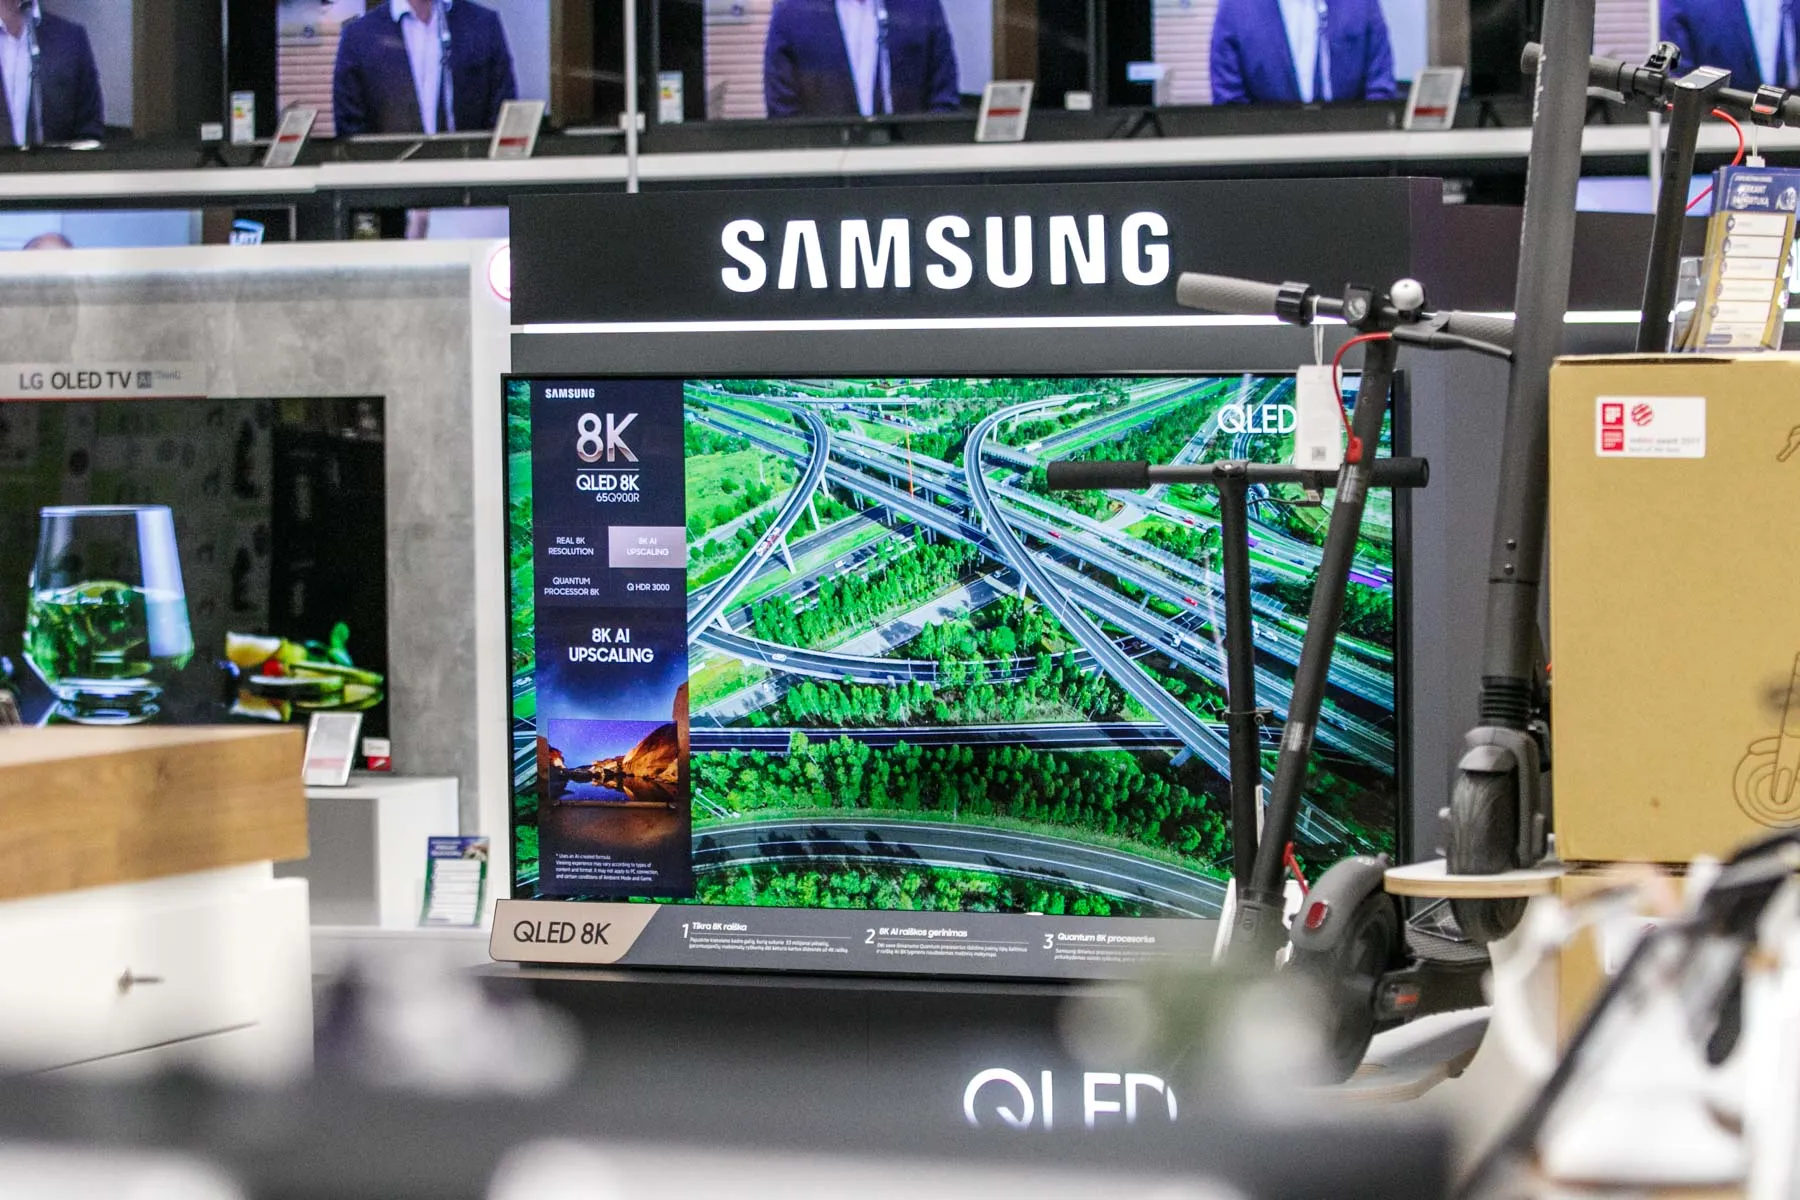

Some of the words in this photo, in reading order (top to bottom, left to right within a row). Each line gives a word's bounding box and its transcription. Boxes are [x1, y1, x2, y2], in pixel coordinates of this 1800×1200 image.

[720, 211, 1171, 293] SAMSUNG
[20, 373, 43, 390] LG
[51, 372, 102, 390] OLED
[105, 371, 132, 389] TV
[545, 388, 595, 399] SAMSUNG
[1217, 403, 1297, 434] QLED
[576, 412, 639, 463] 8K
[576, 474, 617, 491] QLED
[620, 475, 640, 491] 8K
[596, 492, 640, 503] 65Q900R
[556, 537, 574, 545] REAL
[575, 537, 585, 545] 8K
[649, 537, 658, 545] AI
[548, 547, 594, 556] RESOLUTION
[626, 548, 669, 556] UPSCALING
[552, 576, 591, 585] QUANTUM
[626, 582, 634, 591] Q
[635, 583, 651, 591] HDR
[652, 583, 671, 592] 3000
[544, 587, 588, 596] PROCESSOR
[589, 588, 600, 596] 8K
[591, 628, 612, 643] 8K
[614, 628, 630, 643] AI
[568, 647, 655, 663] UPSCALING
[513, 919, 576, 944] QLED
[580, 922, 612, 946] 8K
[864, 928, 876, 944] 2
[928, 928, 968, 938] gerinimas
[1042, 933, 1054, 949] 3
[1057, 932, 1095, 942] Quantum
